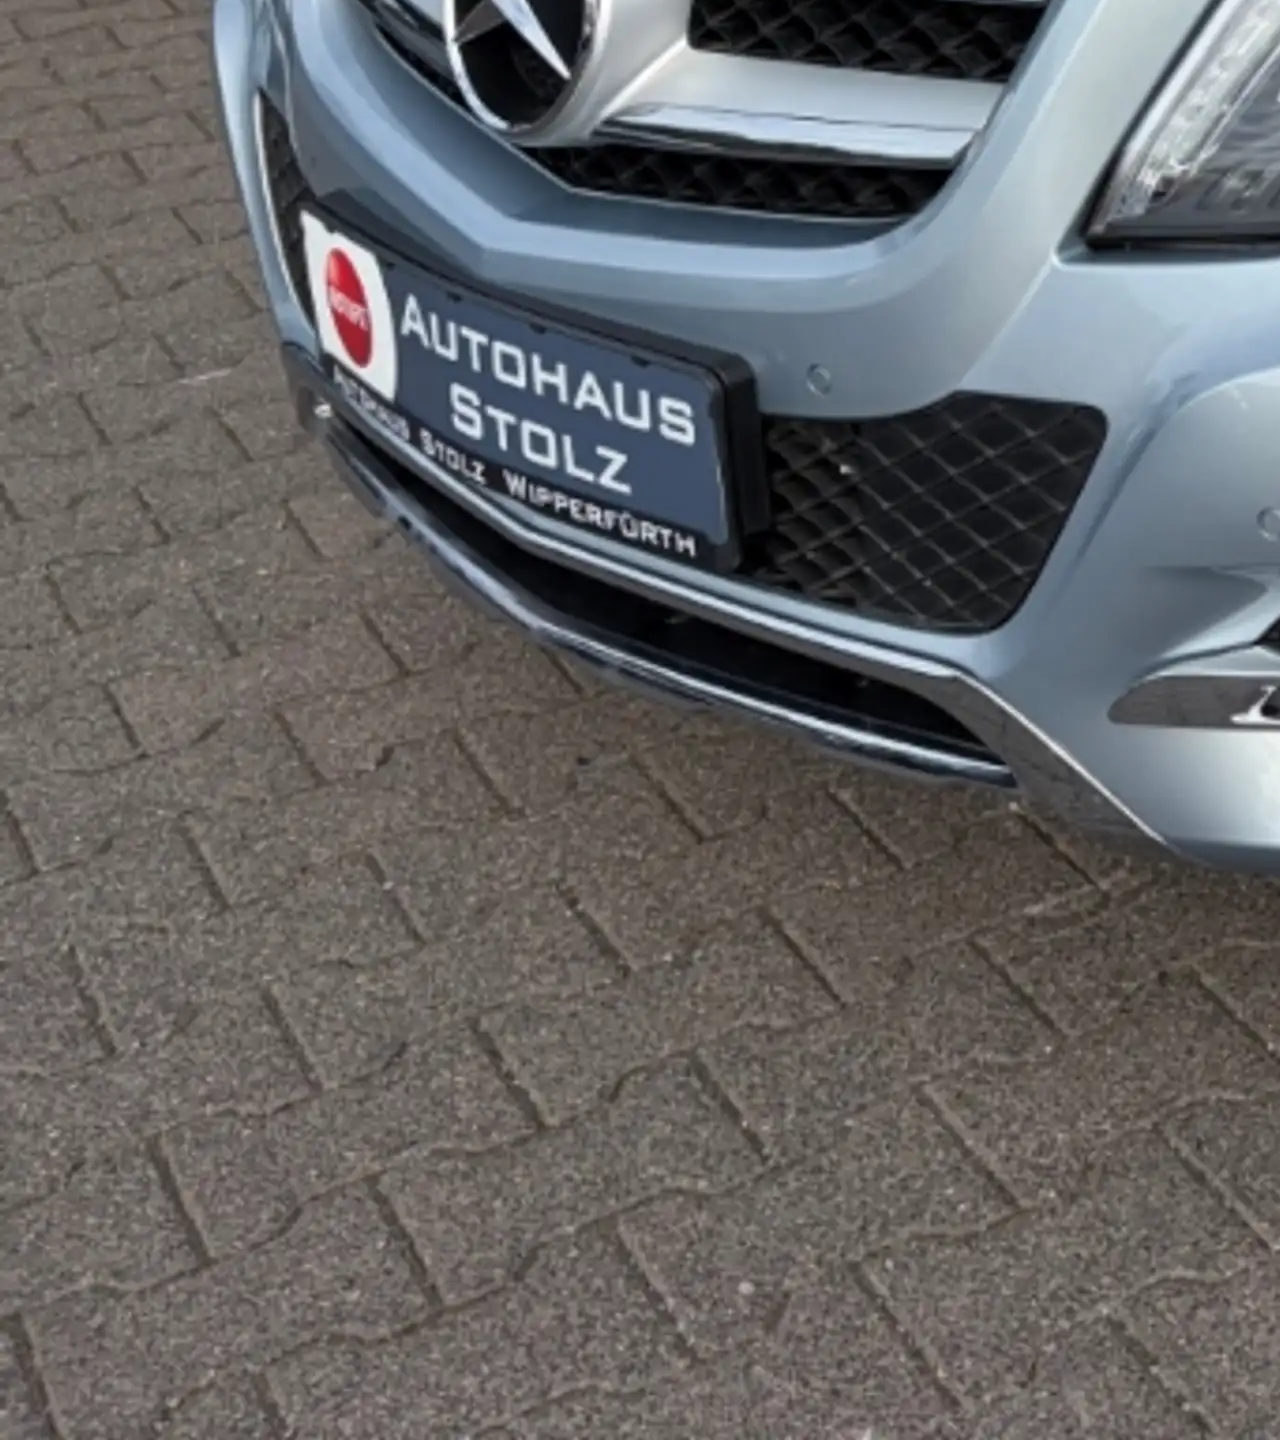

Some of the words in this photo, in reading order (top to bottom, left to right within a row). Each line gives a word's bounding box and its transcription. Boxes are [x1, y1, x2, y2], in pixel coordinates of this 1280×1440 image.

[401, 293, 696, 447] AUTOHAUS
[418, 426, 487, 486] STOLZ
[450, 381, 632, 496] STOLZ
